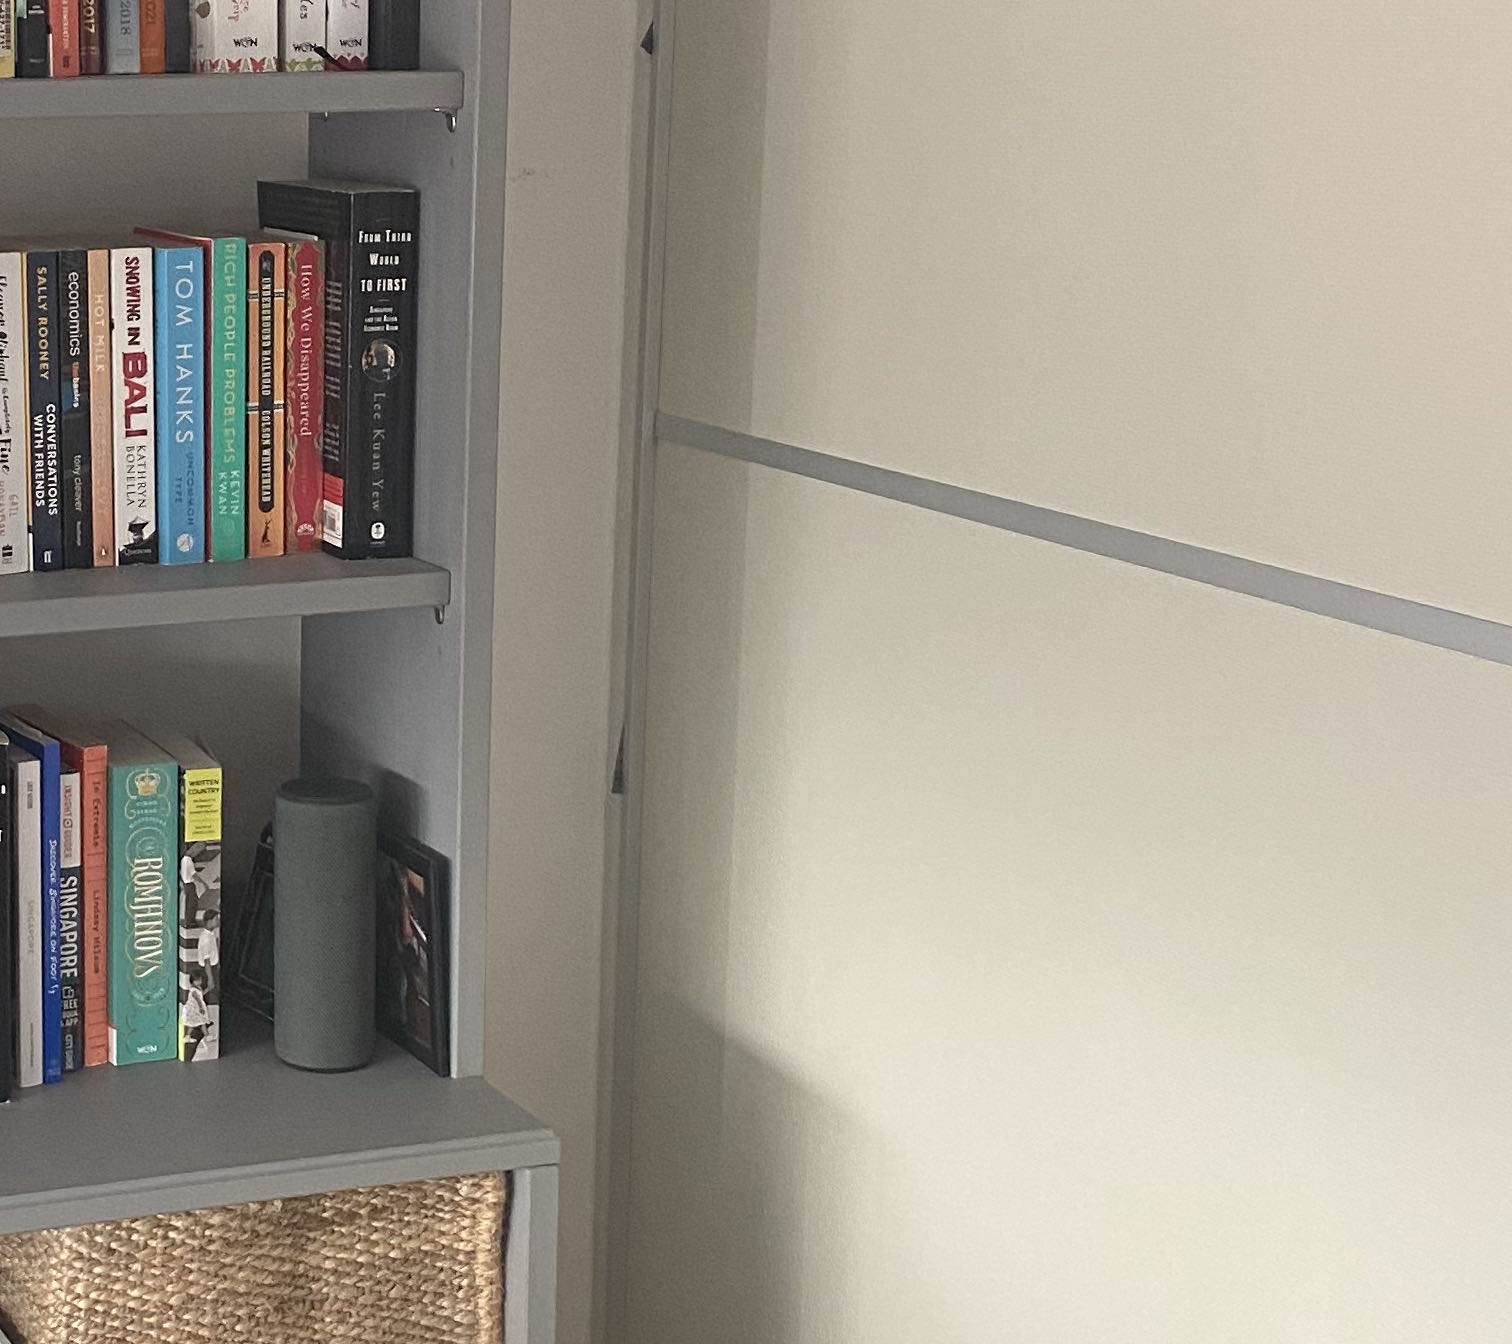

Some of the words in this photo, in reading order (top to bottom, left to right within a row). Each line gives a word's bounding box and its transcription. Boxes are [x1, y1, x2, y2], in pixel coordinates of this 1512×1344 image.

[120, 1, 131, 35] 2018
[36, 267, 49, 310] SALLY
[124, 256, 140, 322] SNOWING
[175, 261, 193, 327] TOM
[300, 264, 312, 301] How
[68, 272, 83, 356] economics
[127, 328, 140, 346] IN
[300, 307, 313, 332] We
[37, 318, 50, 380] ROONEY
[122, 351, 147, 438] BALI
[175, 344, 193, 443] HANKS
[299, 337, 313, 436] Disappeared
[34, 415, 45, 448] WITH
[46, 404, 58, 515] CONVERSATIONS
[35, 453, 46, 507] FRIENDS
[126, 445, 137, 506] BONELLA
[135, 445, 147, 508] KATHRYN
[218, 471, 227, 515] KWAN
[229, 470, 240, 515] KEVIN
[60, 876, 78, 977] SINGAPORE
